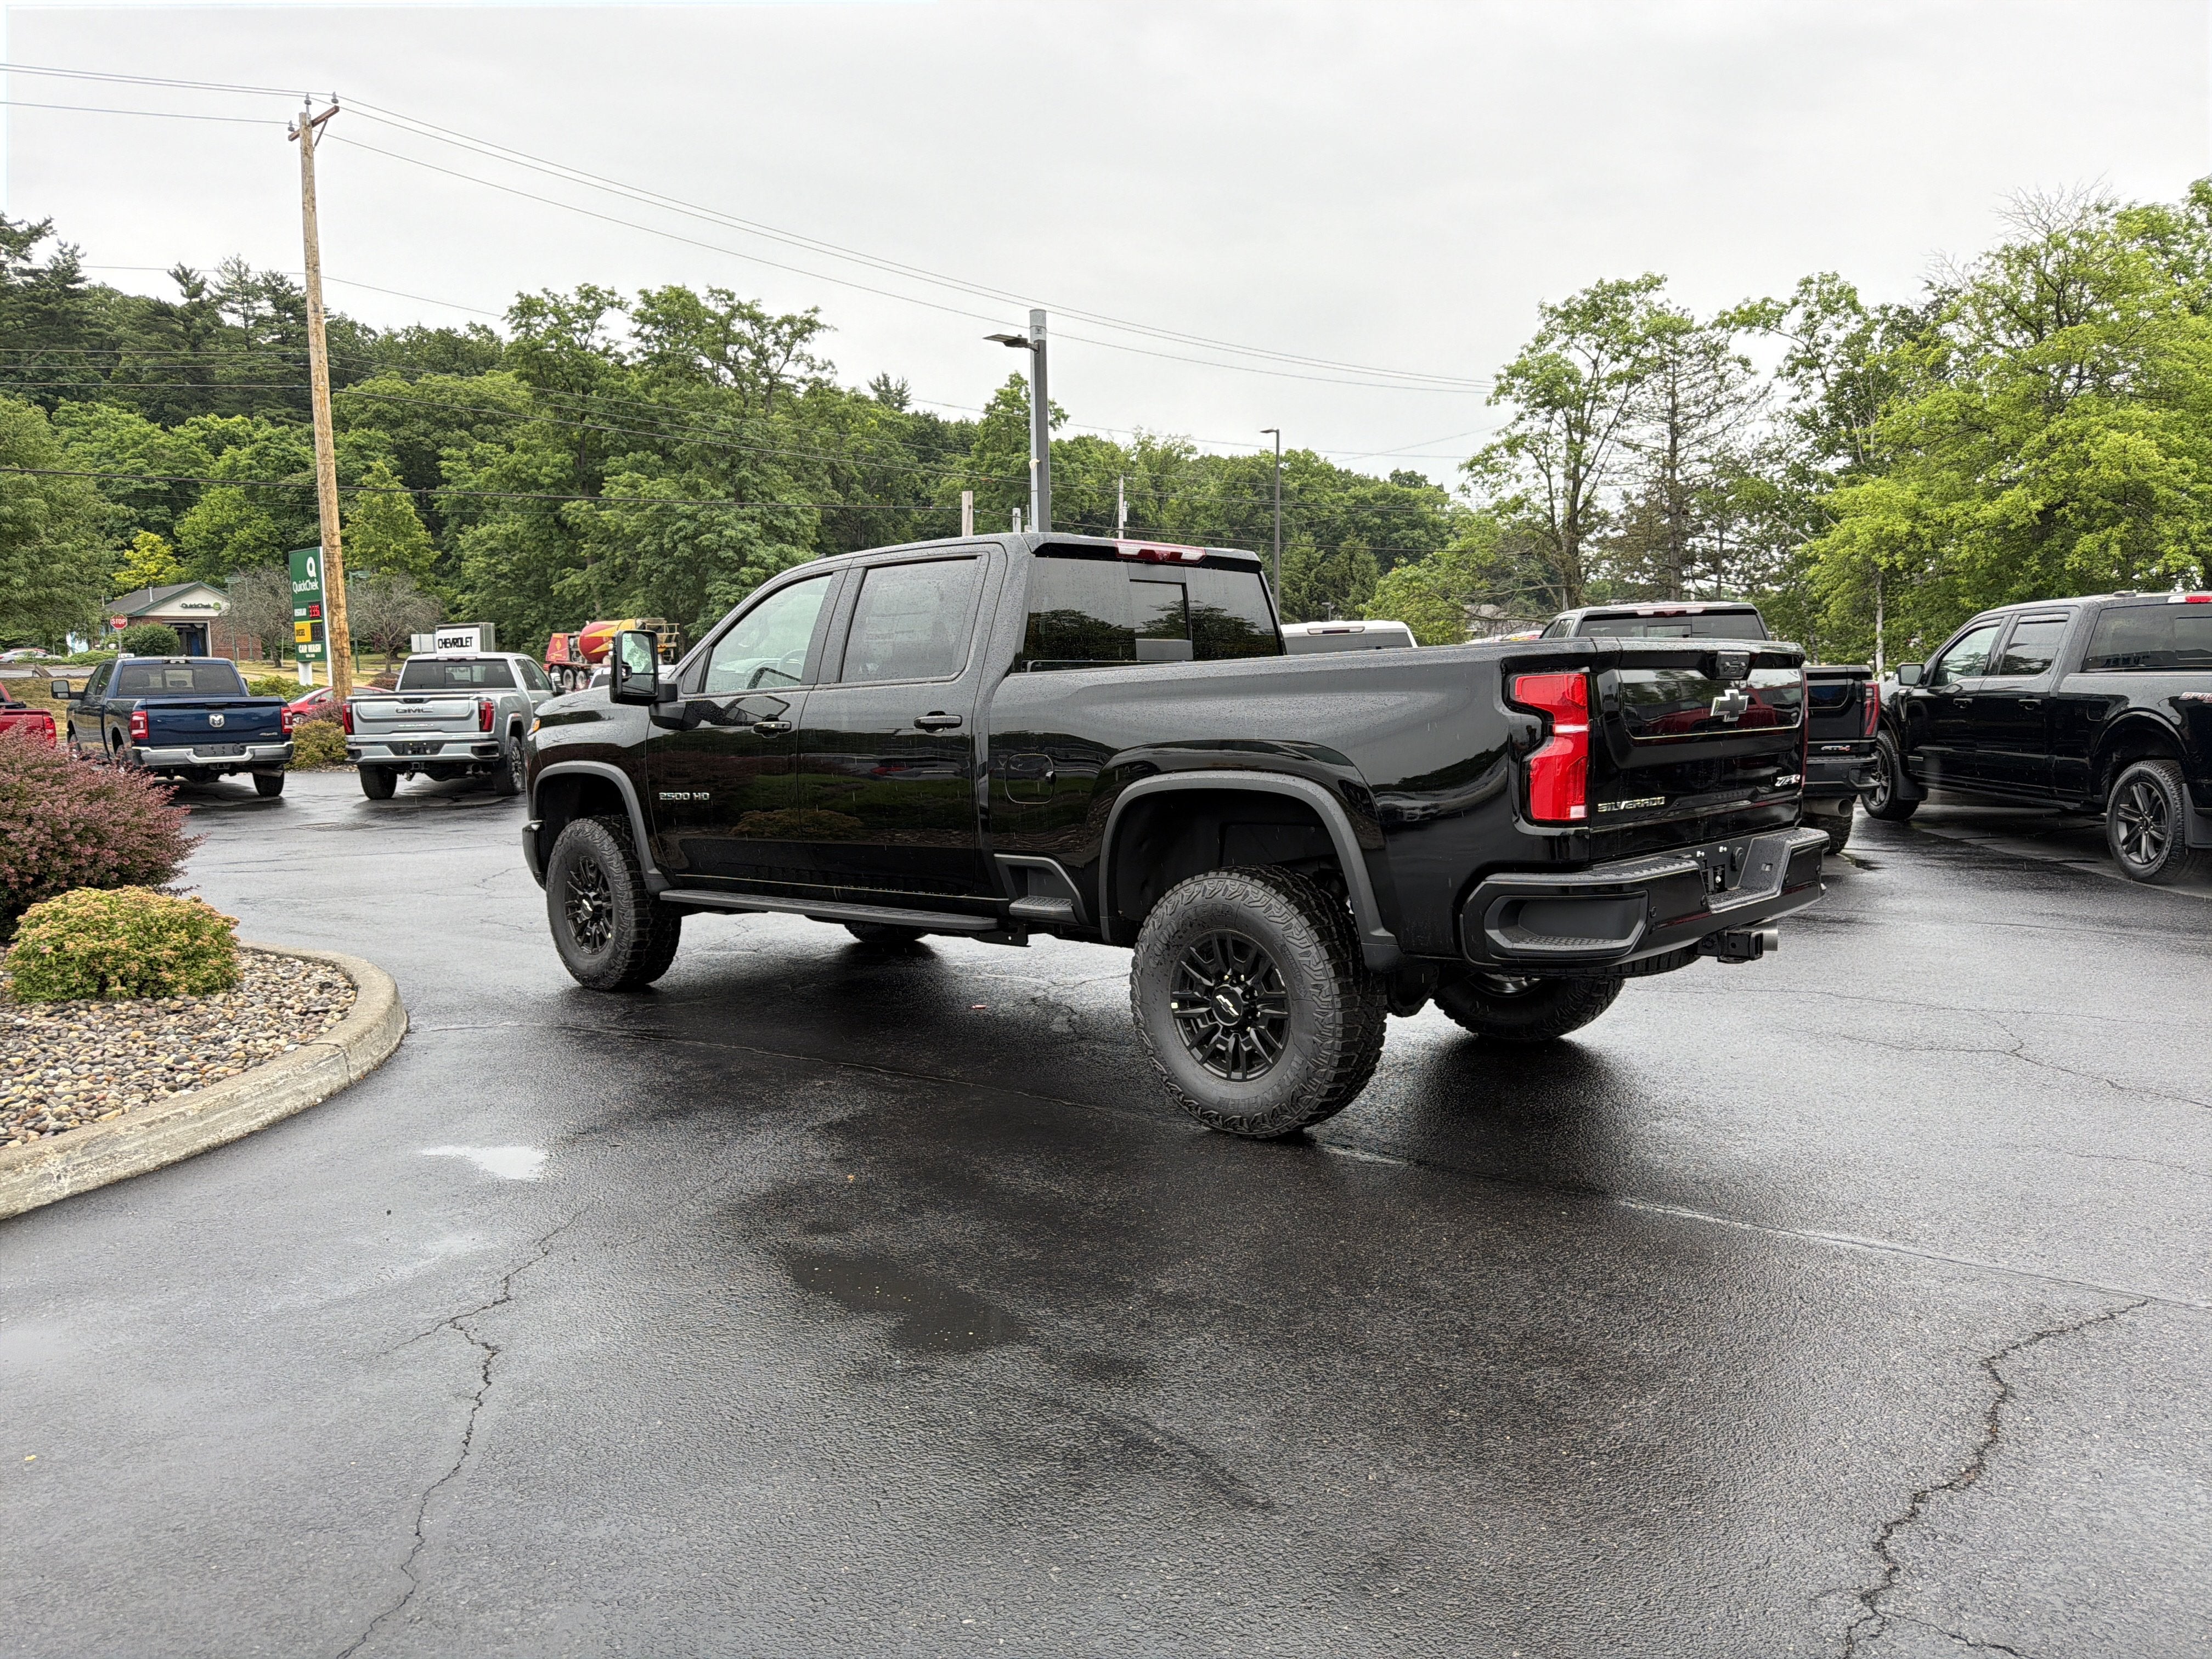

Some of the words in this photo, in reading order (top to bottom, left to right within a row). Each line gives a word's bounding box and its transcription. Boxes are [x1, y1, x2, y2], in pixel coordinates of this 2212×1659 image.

[307, 556, 317, 578] Q
[292, 578, 319, 594] QuickChek
[298, 644, 308, 653] CAR
[438, 636, 473, 648] CHEVROLET
[1598, 796, 1666, 812] SILVERADO
